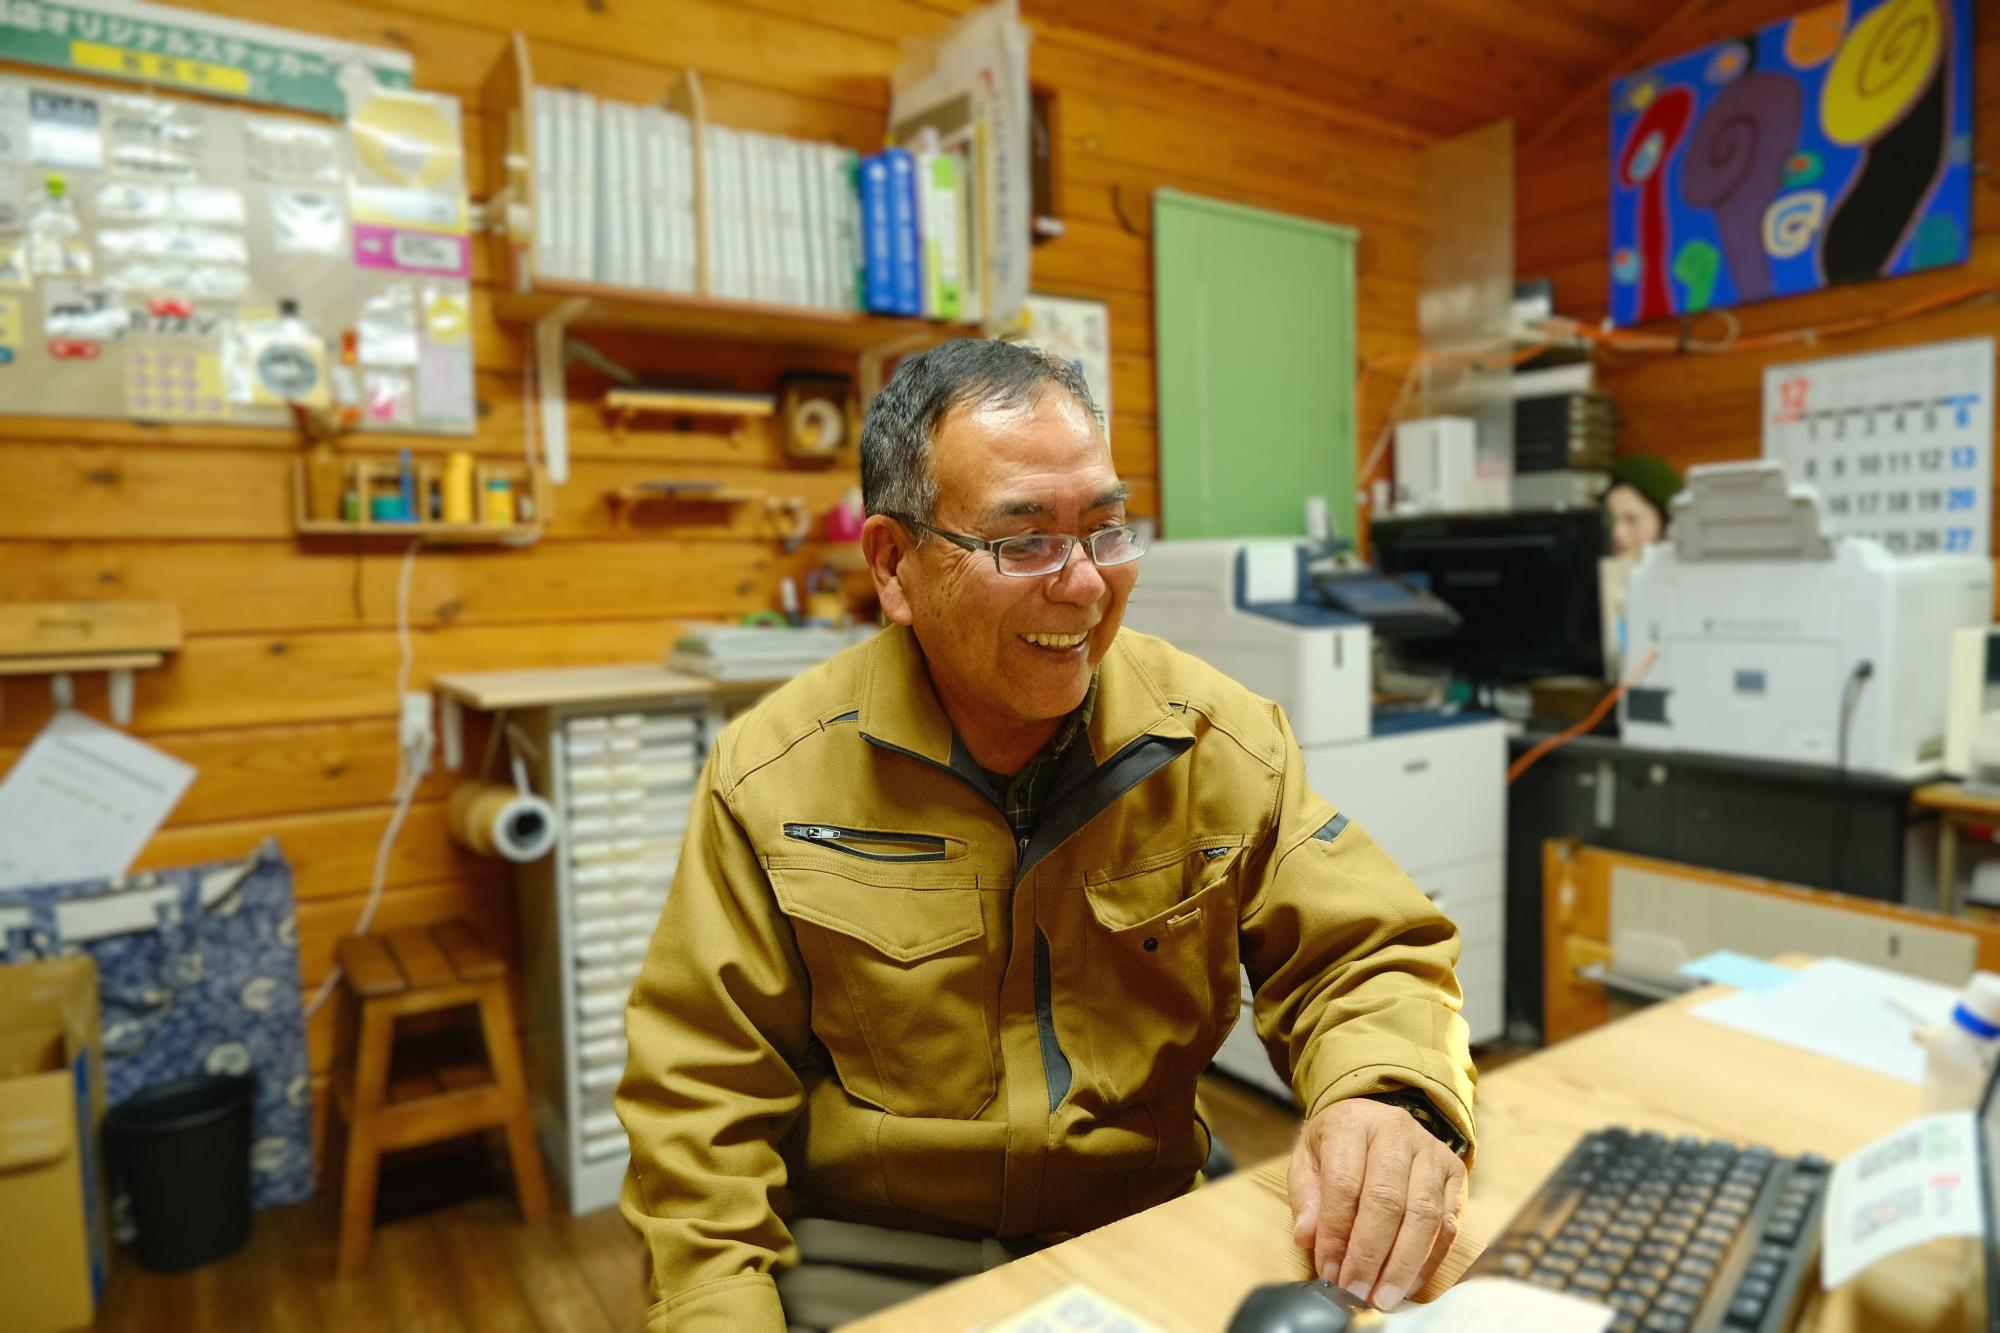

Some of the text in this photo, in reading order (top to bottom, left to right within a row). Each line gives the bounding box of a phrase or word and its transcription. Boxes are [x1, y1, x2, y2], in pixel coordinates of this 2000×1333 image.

[1781, 378, 1808, 408] 12
[1808, 420, 1817, 441] 1
[1834, 418, 1846, 439] 2
[1864, 416, 1876, 437] 3
[1894, 412, 1906, 433] 4
[1925, 410, 1938, 431] 5
[1858, 453, 1881, 474] 10
[1888, 452, 1910, 472] 11
[1919, 449, 1942, 471] 12
[1951, 446, 1976, 469] 13
[1858, 493, 1880, 514] 17
[1946, 487, 1976, 511] 20
[1945, 528, 1973, 552] 27
